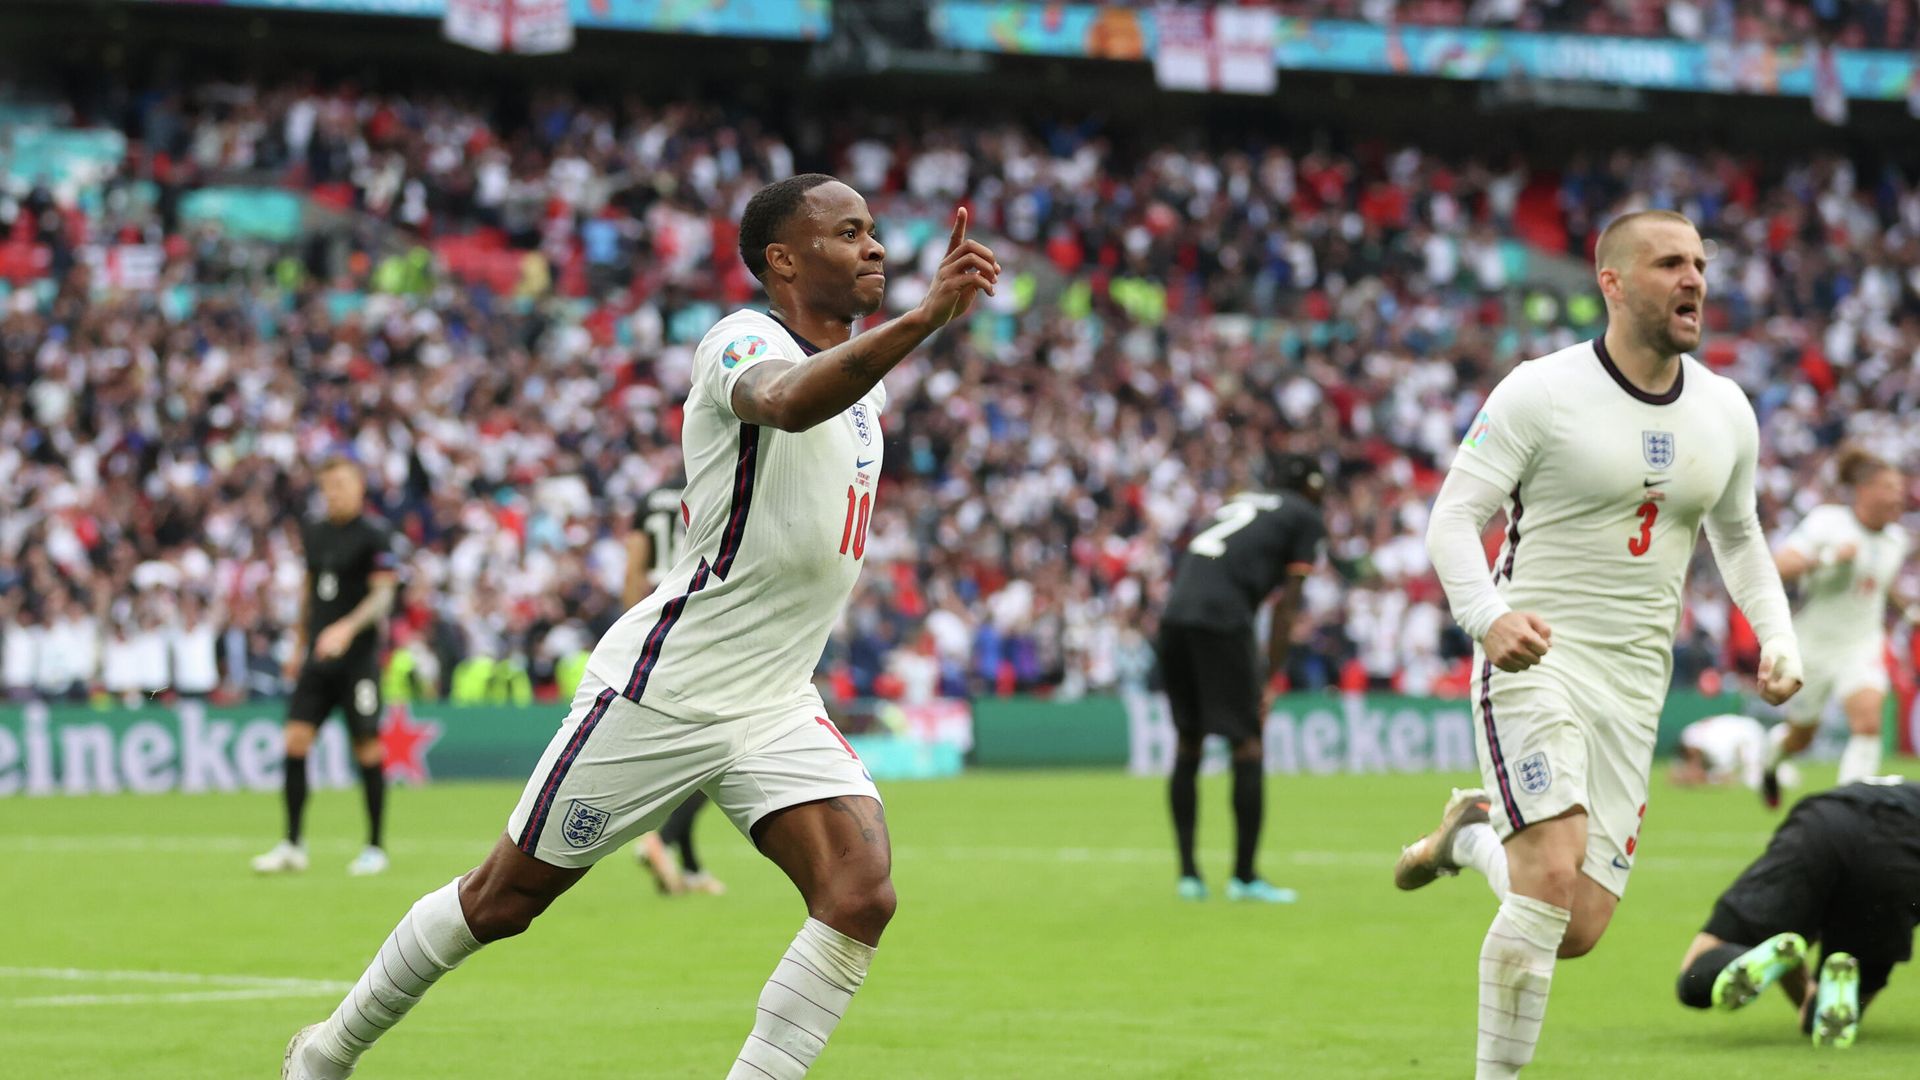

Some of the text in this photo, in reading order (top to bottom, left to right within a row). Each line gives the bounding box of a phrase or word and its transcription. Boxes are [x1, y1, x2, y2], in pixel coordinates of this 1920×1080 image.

[839, 484, 871, 561] 10
[1189, 500, 1258, 558] 2
[1627, 501, 1659, 557] 3
[354, 678, 378, 716] 8
